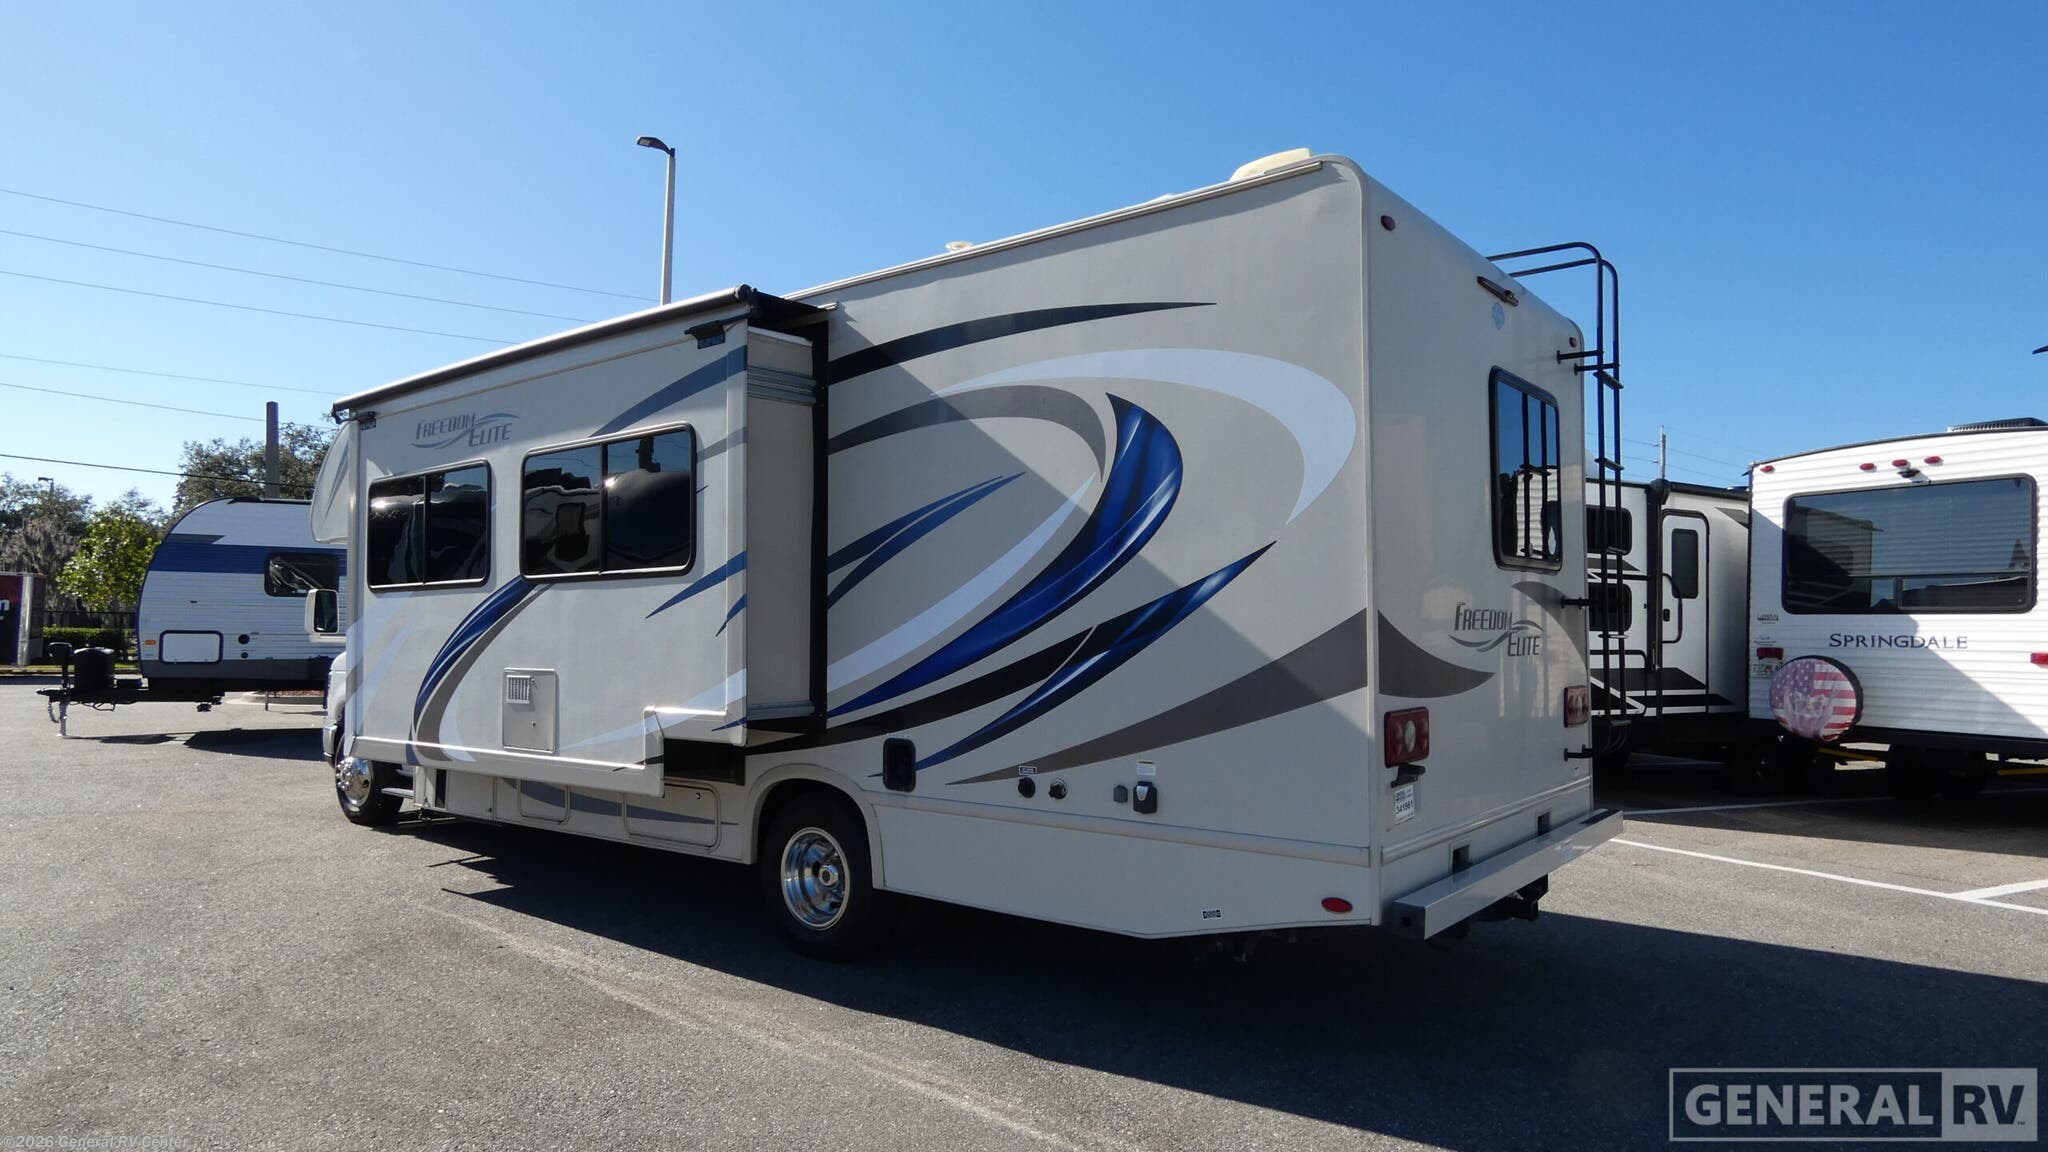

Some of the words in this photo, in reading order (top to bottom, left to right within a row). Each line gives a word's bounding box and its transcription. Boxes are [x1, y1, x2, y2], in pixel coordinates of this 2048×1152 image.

[416, 412, 476, 440] FREEDOM
[468, 423, 512, 447] ELITE
[1454, 602, 1513, 630] FREEDOM
[1507, 631, 1540, 656] ELITE
[1829, 633, 1968, 649] SPRINGDALE
